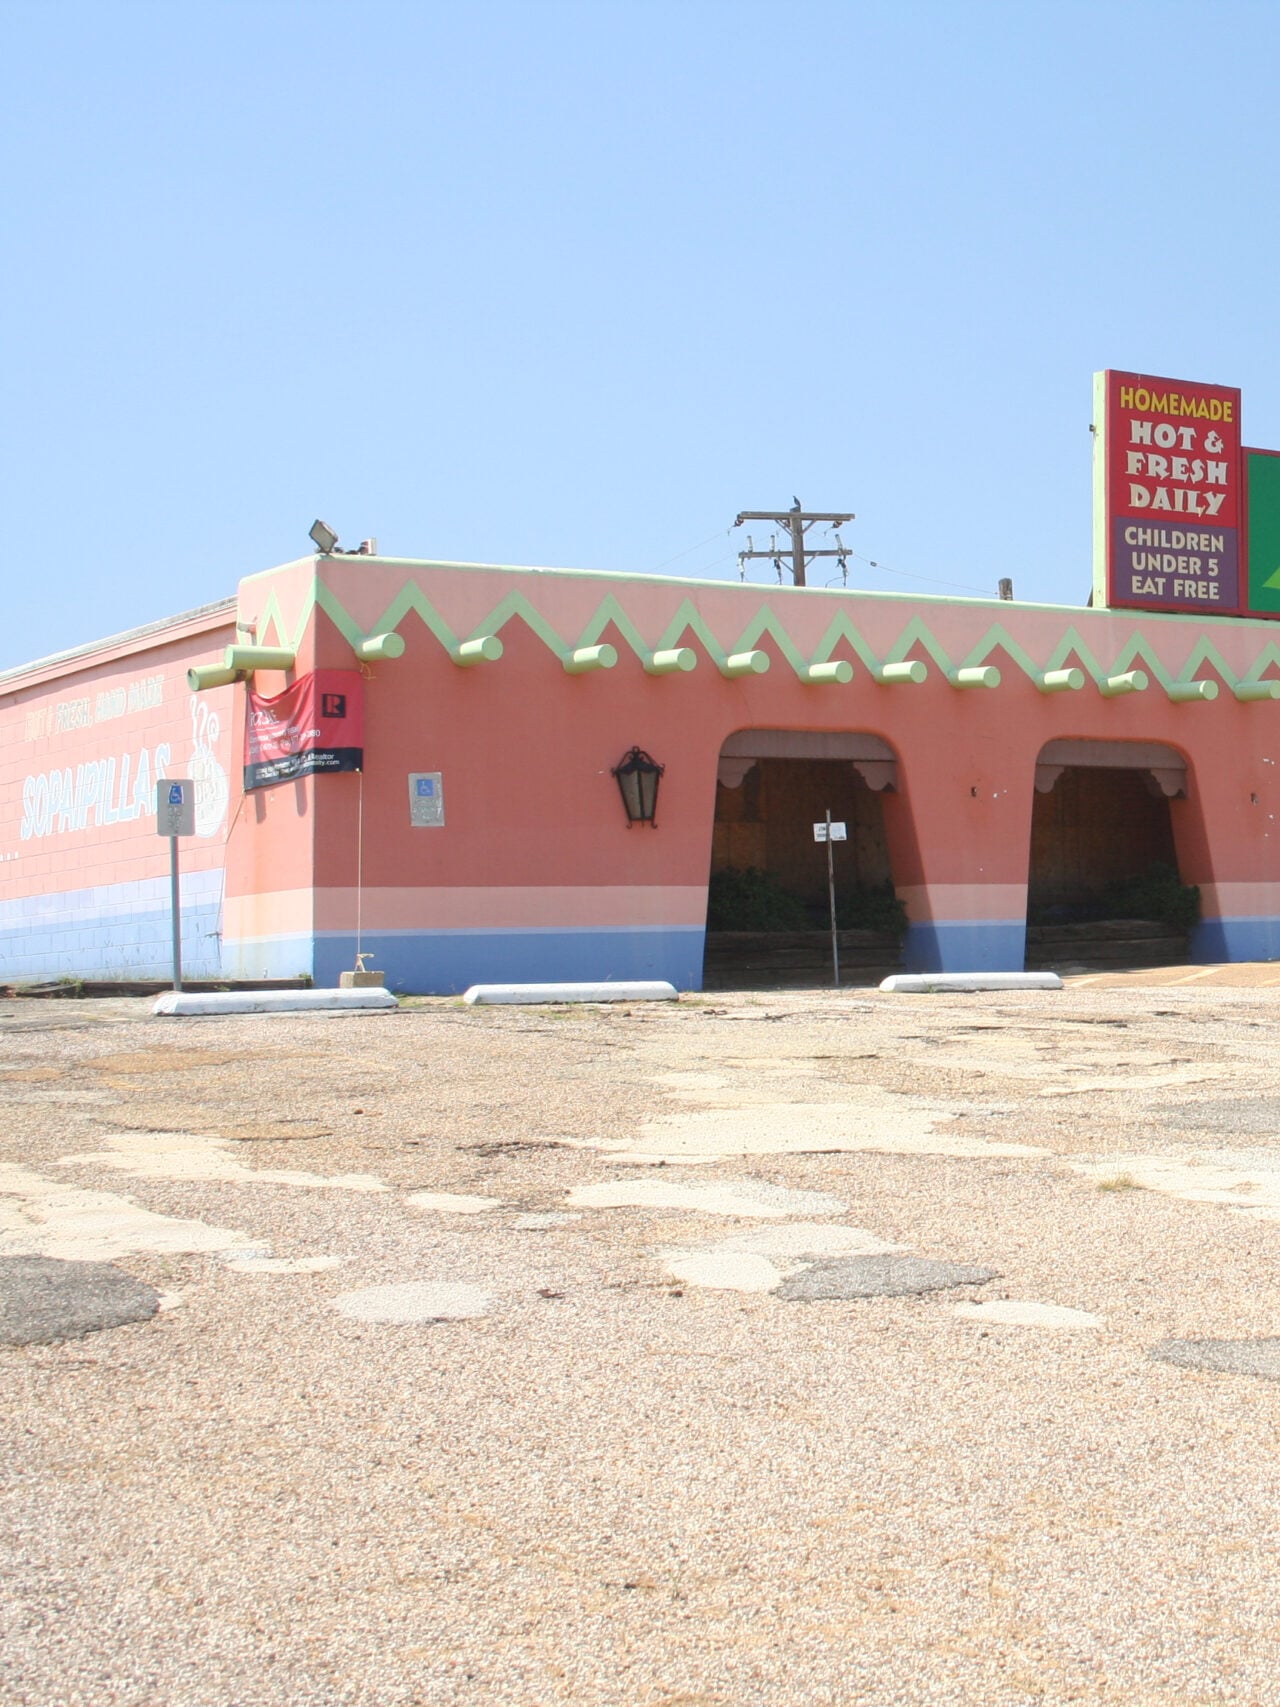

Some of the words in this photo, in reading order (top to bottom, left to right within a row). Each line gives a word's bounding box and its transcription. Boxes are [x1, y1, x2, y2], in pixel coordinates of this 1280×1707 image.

[1120, 386, 1233, 423] HOMEMADE
[1129, 419, 1197, 451] HOT
[1203, 430, 1224, 454] &
[1125, 450, 1228, 485] FRESH
[1128, 483, 1226, 517] DAILY
[1124, 526, 1224, 553] CHILDREN
[1131, 552, 1202, 575] UNDER
[1207, 558, 1219, 577] 5
[1131, 575, 1166, 596] EAT
[1173, 579, 1220, 600] FREE
